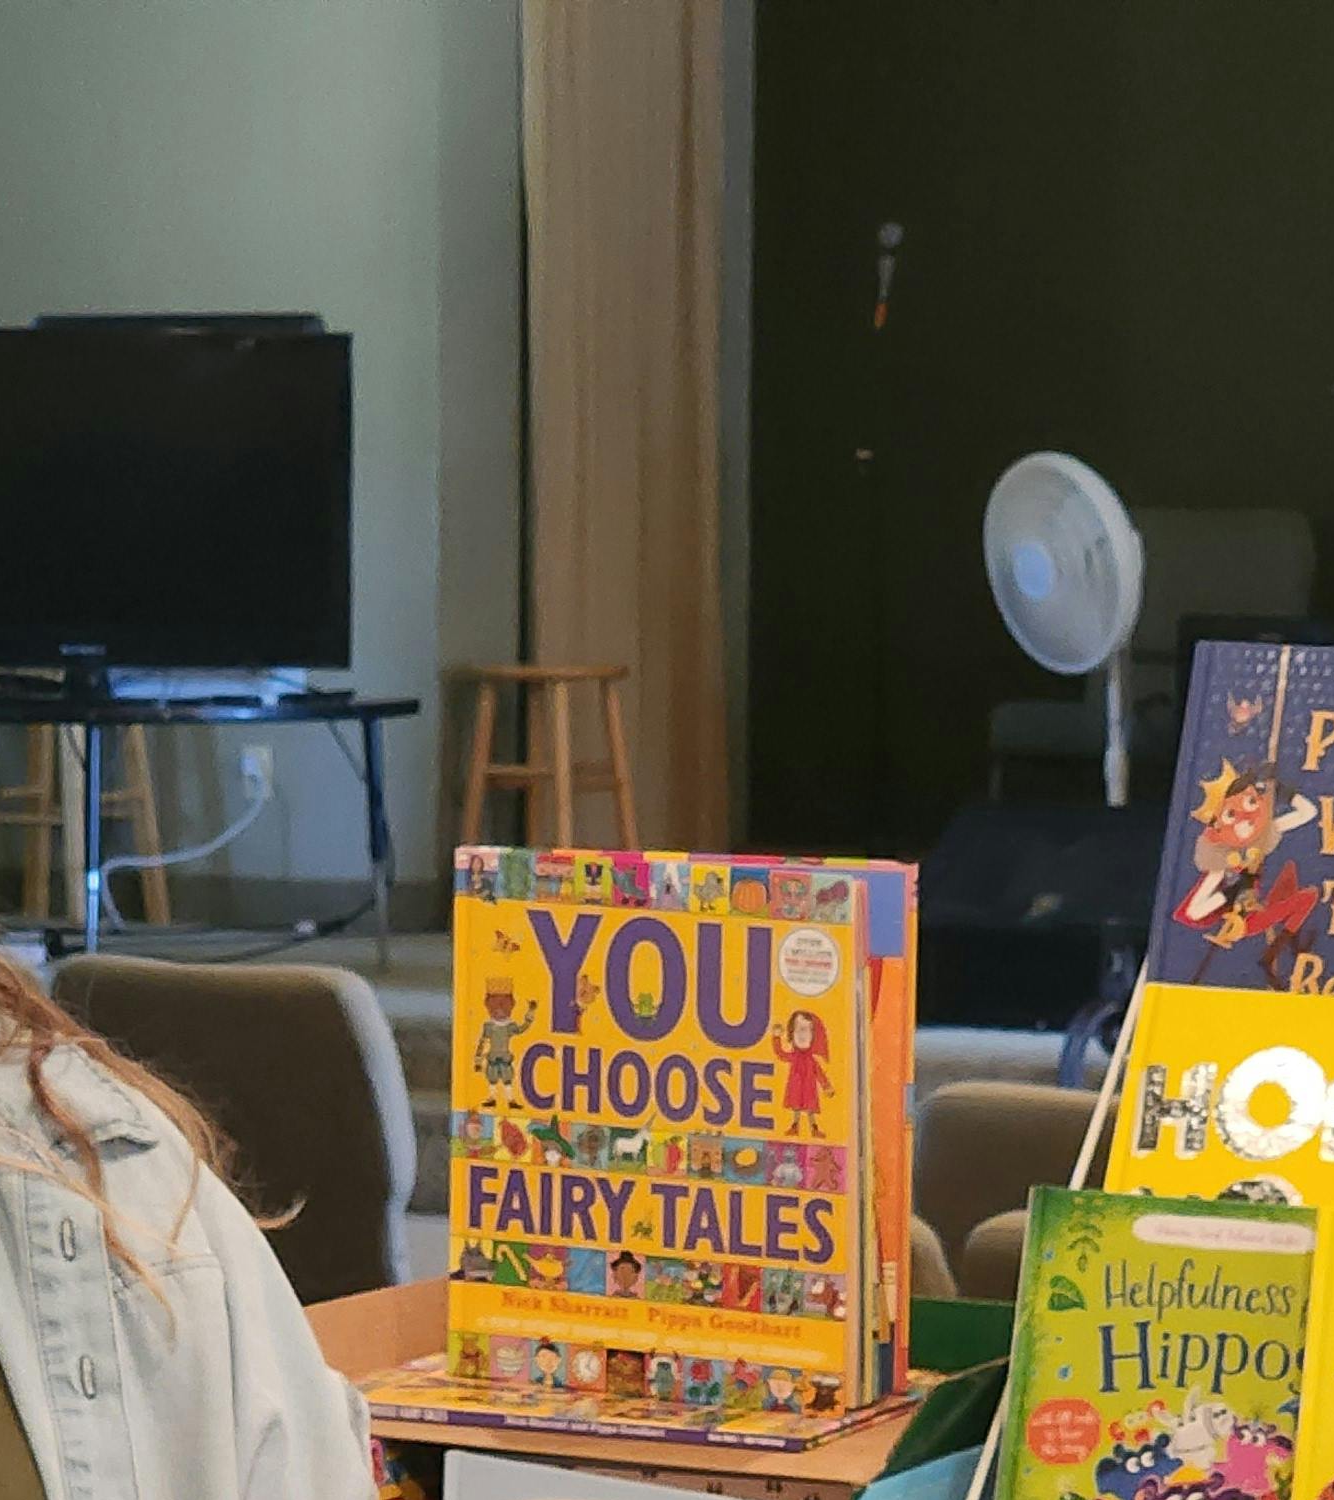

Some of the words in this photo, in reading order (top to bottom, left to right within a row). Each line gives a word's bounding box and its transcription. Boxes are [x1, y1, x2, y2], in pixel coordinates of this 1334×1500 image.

[527, 909, 774, 1049] YOU
[520, 1042, 775, 1129] CHOOSE
[467, 1165, 637, 1245] FAIRY
[652, 1181, 835, 1264] TALES
[648, 1308, 702, 1330] Pippa
[1104, 1258, 1298, 1323] Helpfulness
